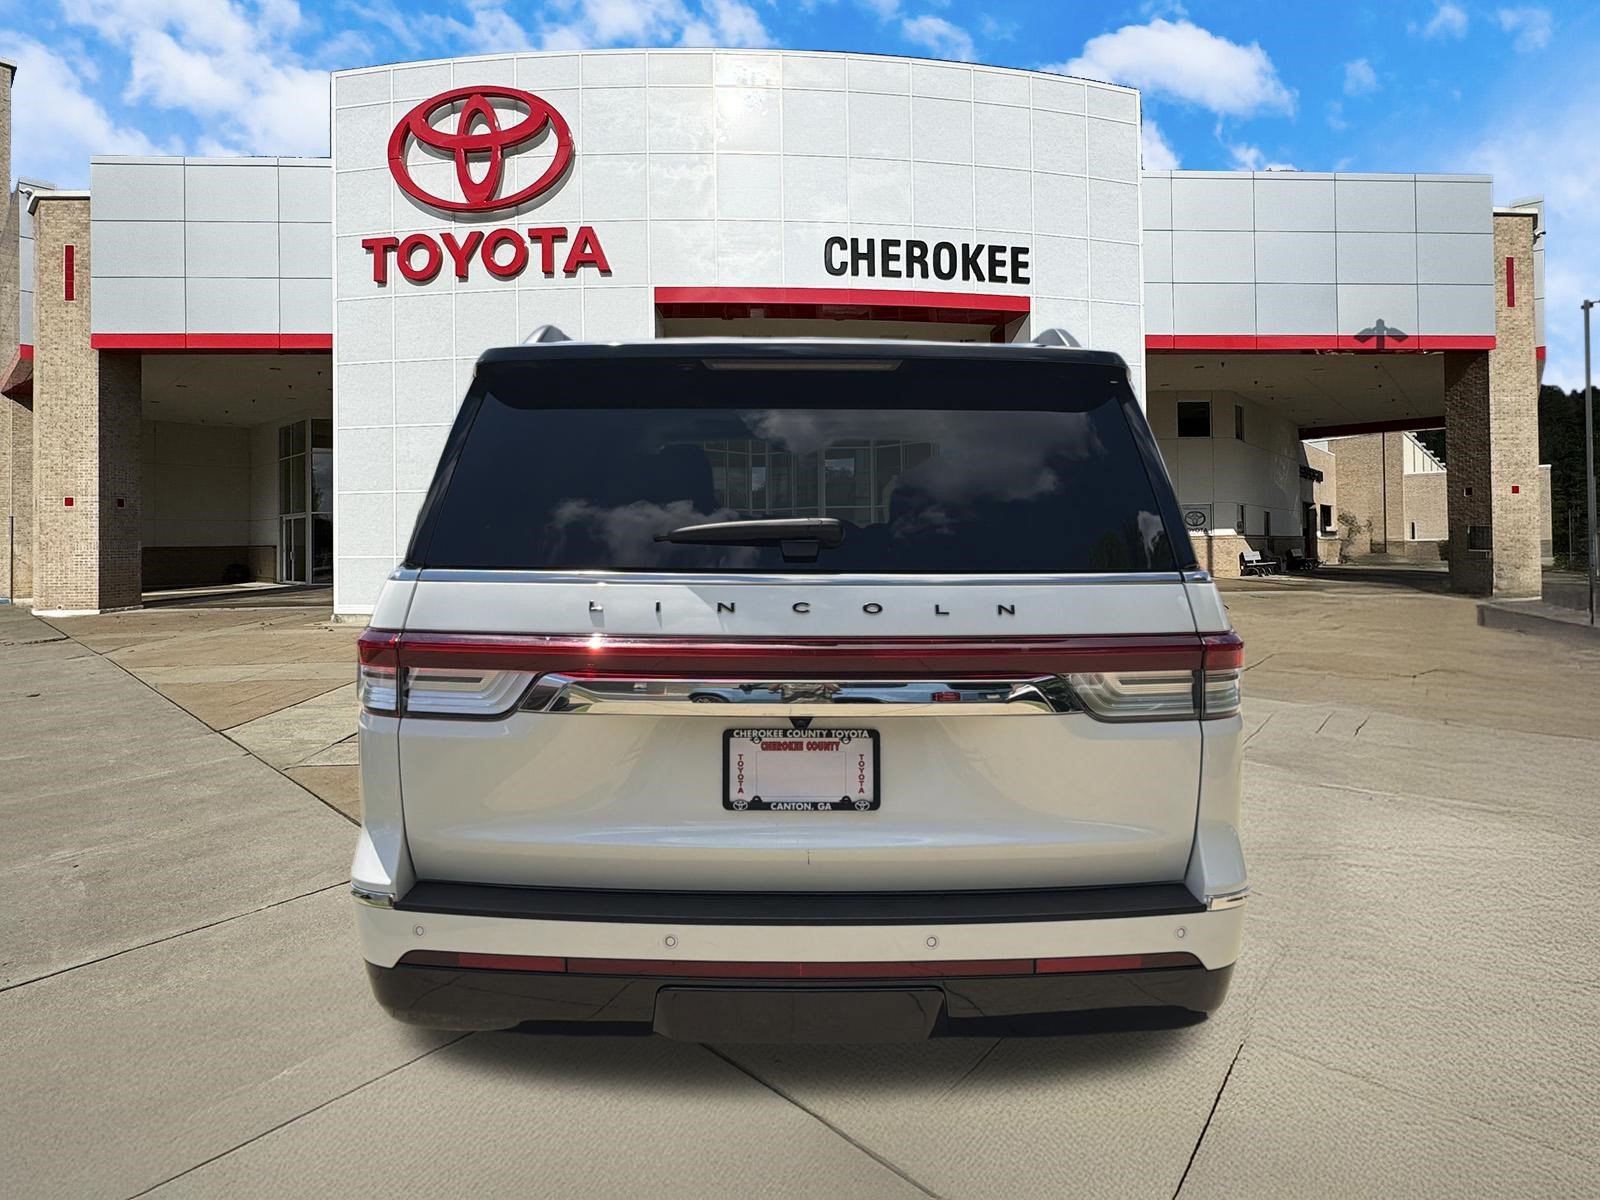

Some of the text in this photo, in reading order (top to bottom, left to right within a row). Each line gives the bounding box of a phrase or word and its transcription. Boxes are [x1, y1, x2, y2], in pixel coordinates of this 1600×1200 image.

[361, 226, 612, 284] TOYOTA
[824, 236, 1031, 284] CHEROKEE
[588, 601, 1016, 616] LINCOLN
[733, 729, 870, 738] CHEROKEE COUNTY TOYOTA
[761, 741, 841, 751] CHEROKEE COUNTY
[770, 802, 832, 811] CANTON, GA
